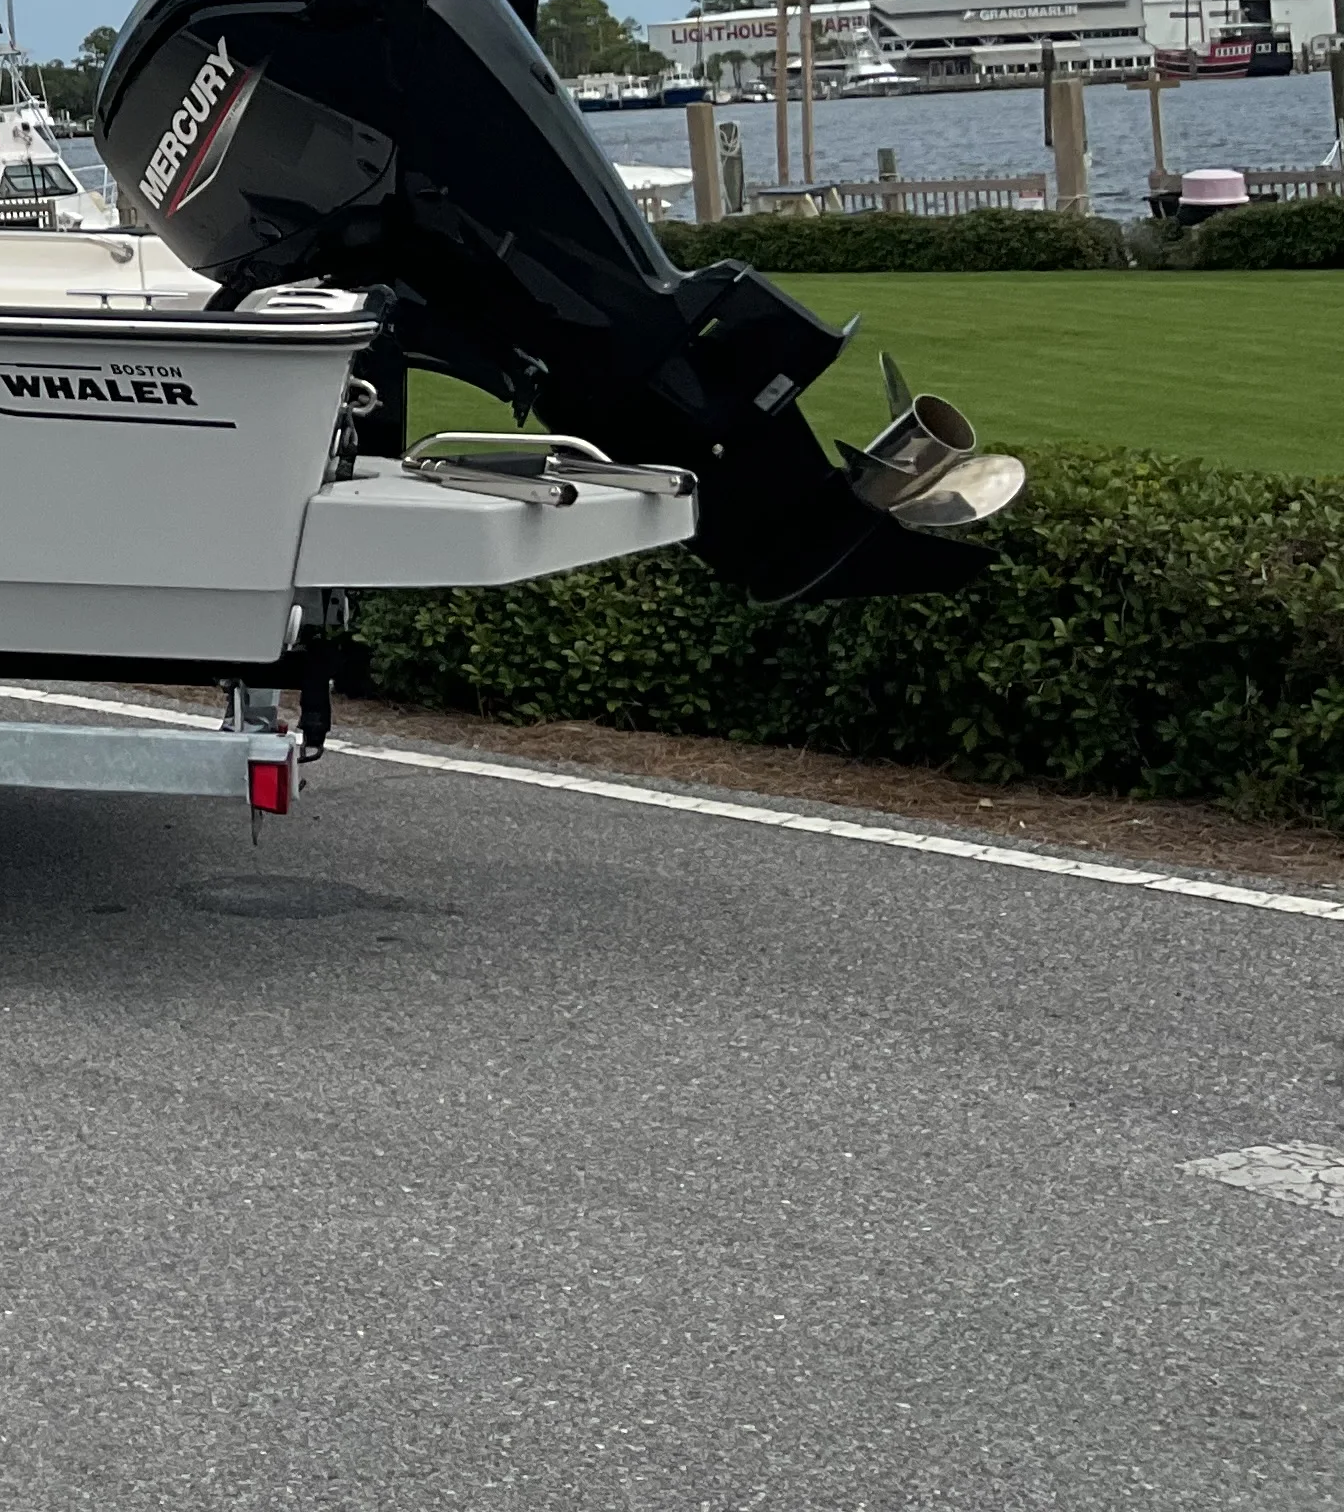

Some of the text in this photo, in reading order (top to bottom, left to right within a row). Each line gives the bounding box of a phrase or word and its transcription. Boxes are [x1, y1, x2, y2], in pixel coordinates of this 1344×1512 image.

[671, 21, 790, 44] LIGHTHOUS
[139, 35, 235, 210] MERCURY
[110, 364, 182, 378] BOSTON
[0, 374, 199, 406] WHALER
